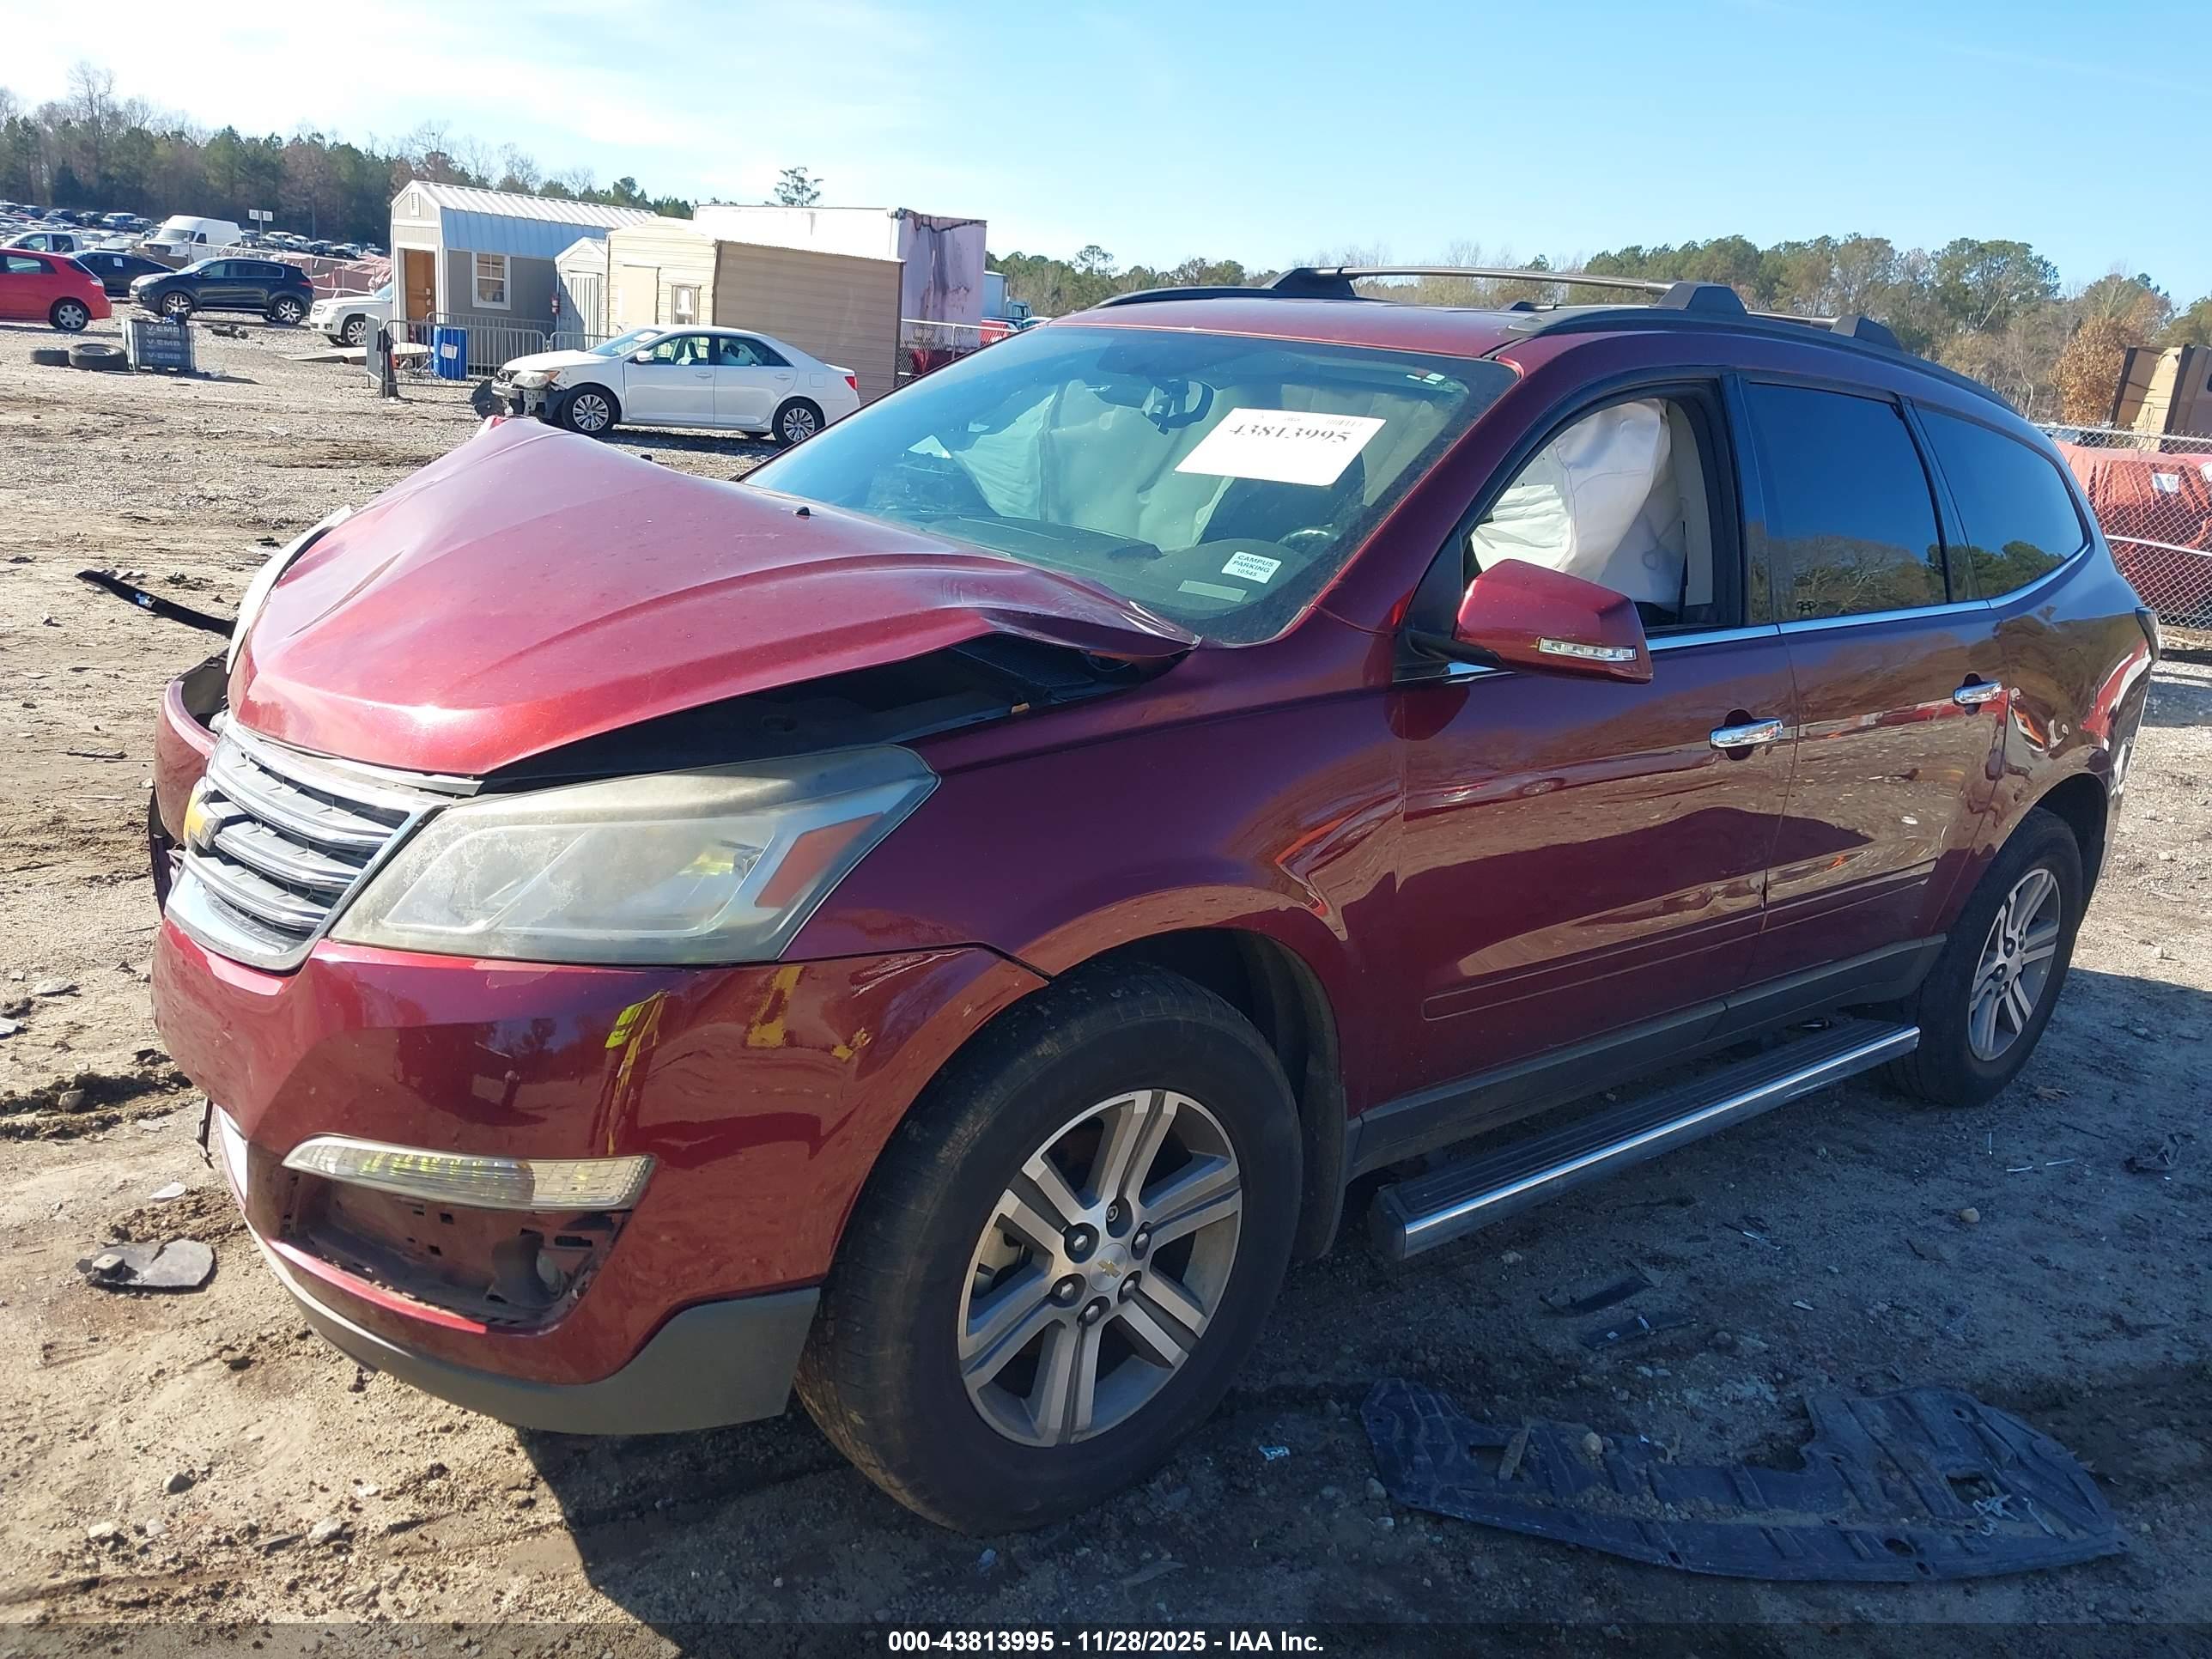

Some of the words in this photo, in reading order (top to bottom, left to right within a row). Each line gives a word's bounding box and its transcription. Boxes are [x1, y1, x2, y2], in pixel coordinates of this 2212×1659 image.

[1229, 423, 1352, 444] 43813995
[1232, 560, 1271, 574] PARKING
[1237, 555, 1275, 568] CAMPUS
